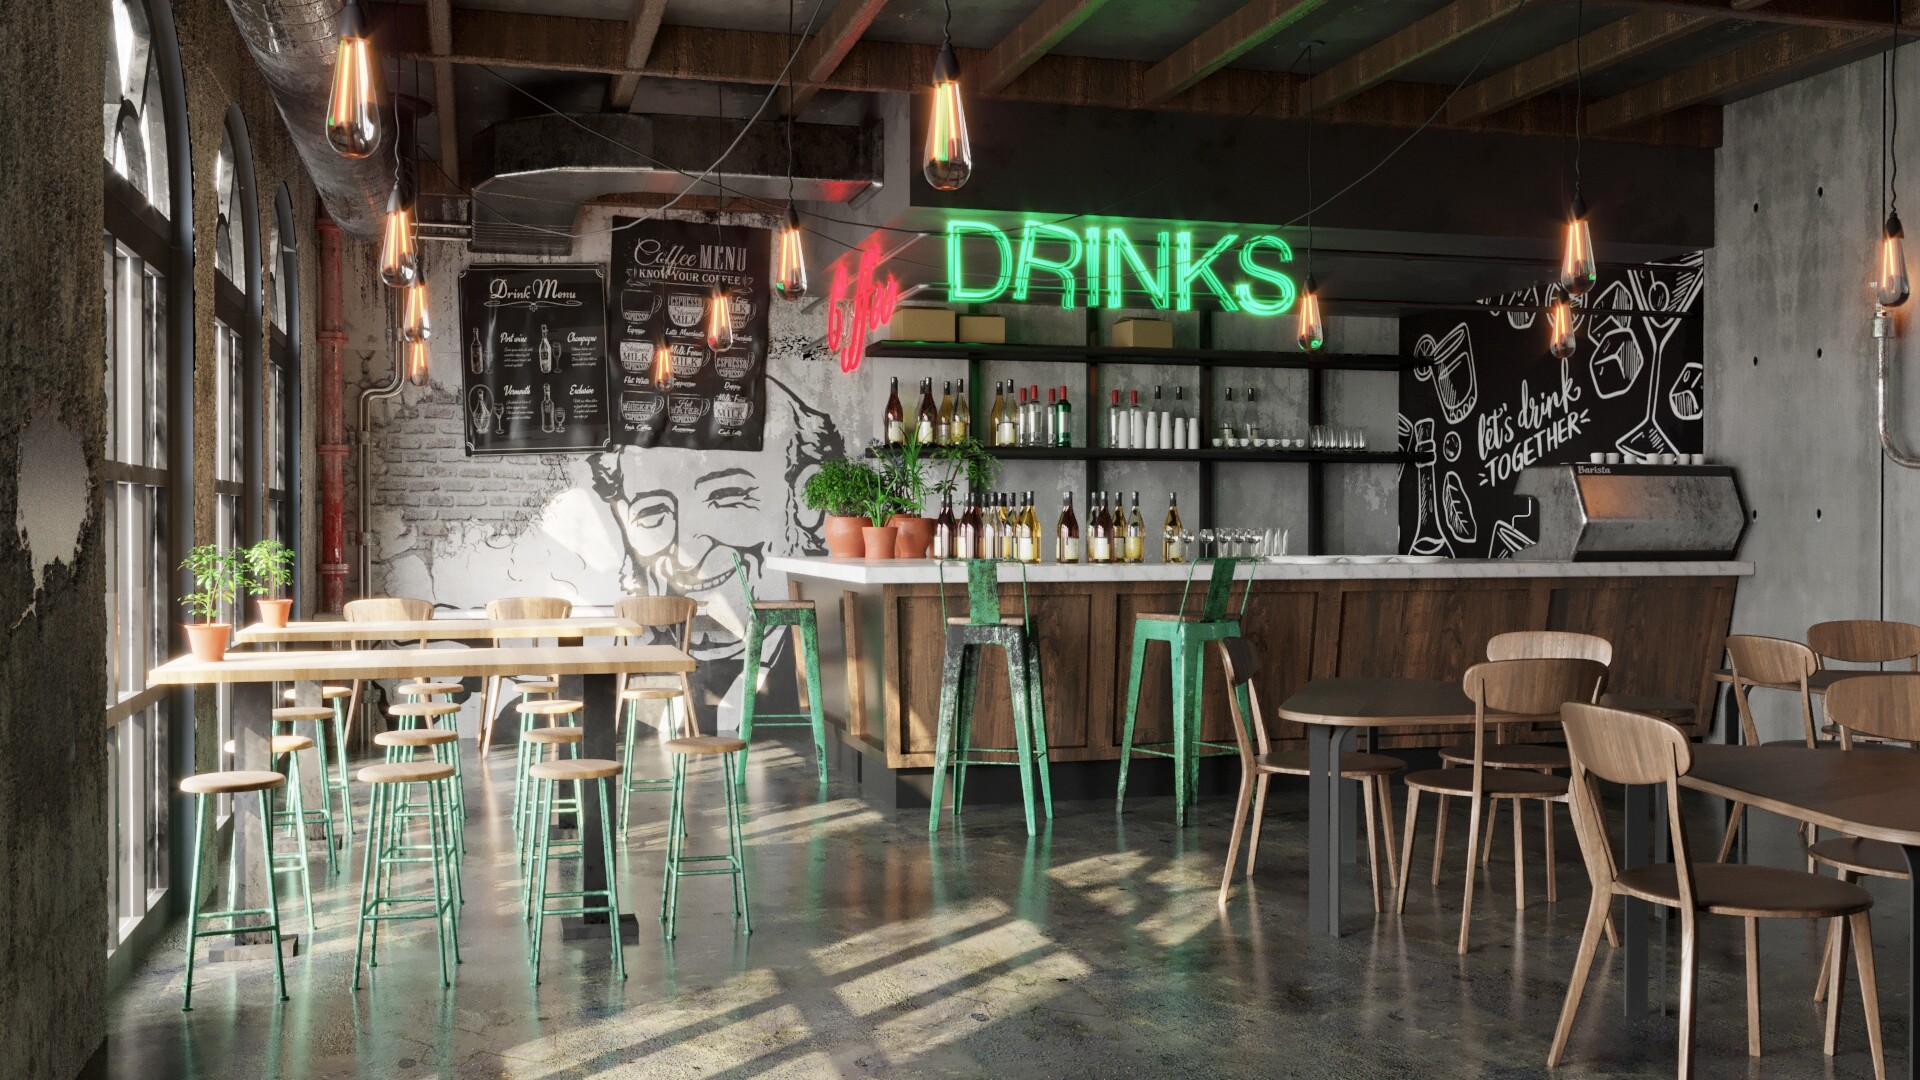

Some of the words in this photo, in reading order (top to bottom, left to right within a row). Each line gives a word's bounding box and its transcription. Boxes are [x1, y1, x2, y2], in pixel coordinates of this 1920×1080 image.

[634, 238, 697, 276] Coffee
[700, 244, 747, 272] MENU
[946, 220, 1296, 316] DRINKS
[639, 268, 668, 279] KNOW
[673, 271, 699, 283] YOUR
[701, 274, 741, 286] COFFEE
[490, 278, 531, 299] Drink
[532, 278, 577, 299] Menu
[671, 314, 696, 324] MILK
[500, 332, 514, 343] Port
[514, 334, 528, 343] wine
[670, 344, 686, 356] Milk
[623, 352, 648, 361] MILK
[671, 356, 698, 366] MILK
[504, 385, 531, 396] Vermouth
[569, 384, 595, 396] Exclusive
[622, 402, 654, 412] WHISKEY
[670, 403, 701, 416] WATER
[1478, 403, 1515, 460] let's
[1518, 357, 1581, 430] drink
[1485, 411, 1581, 487] TOGETHER
[1577, 465, 1611, 474] Barista
